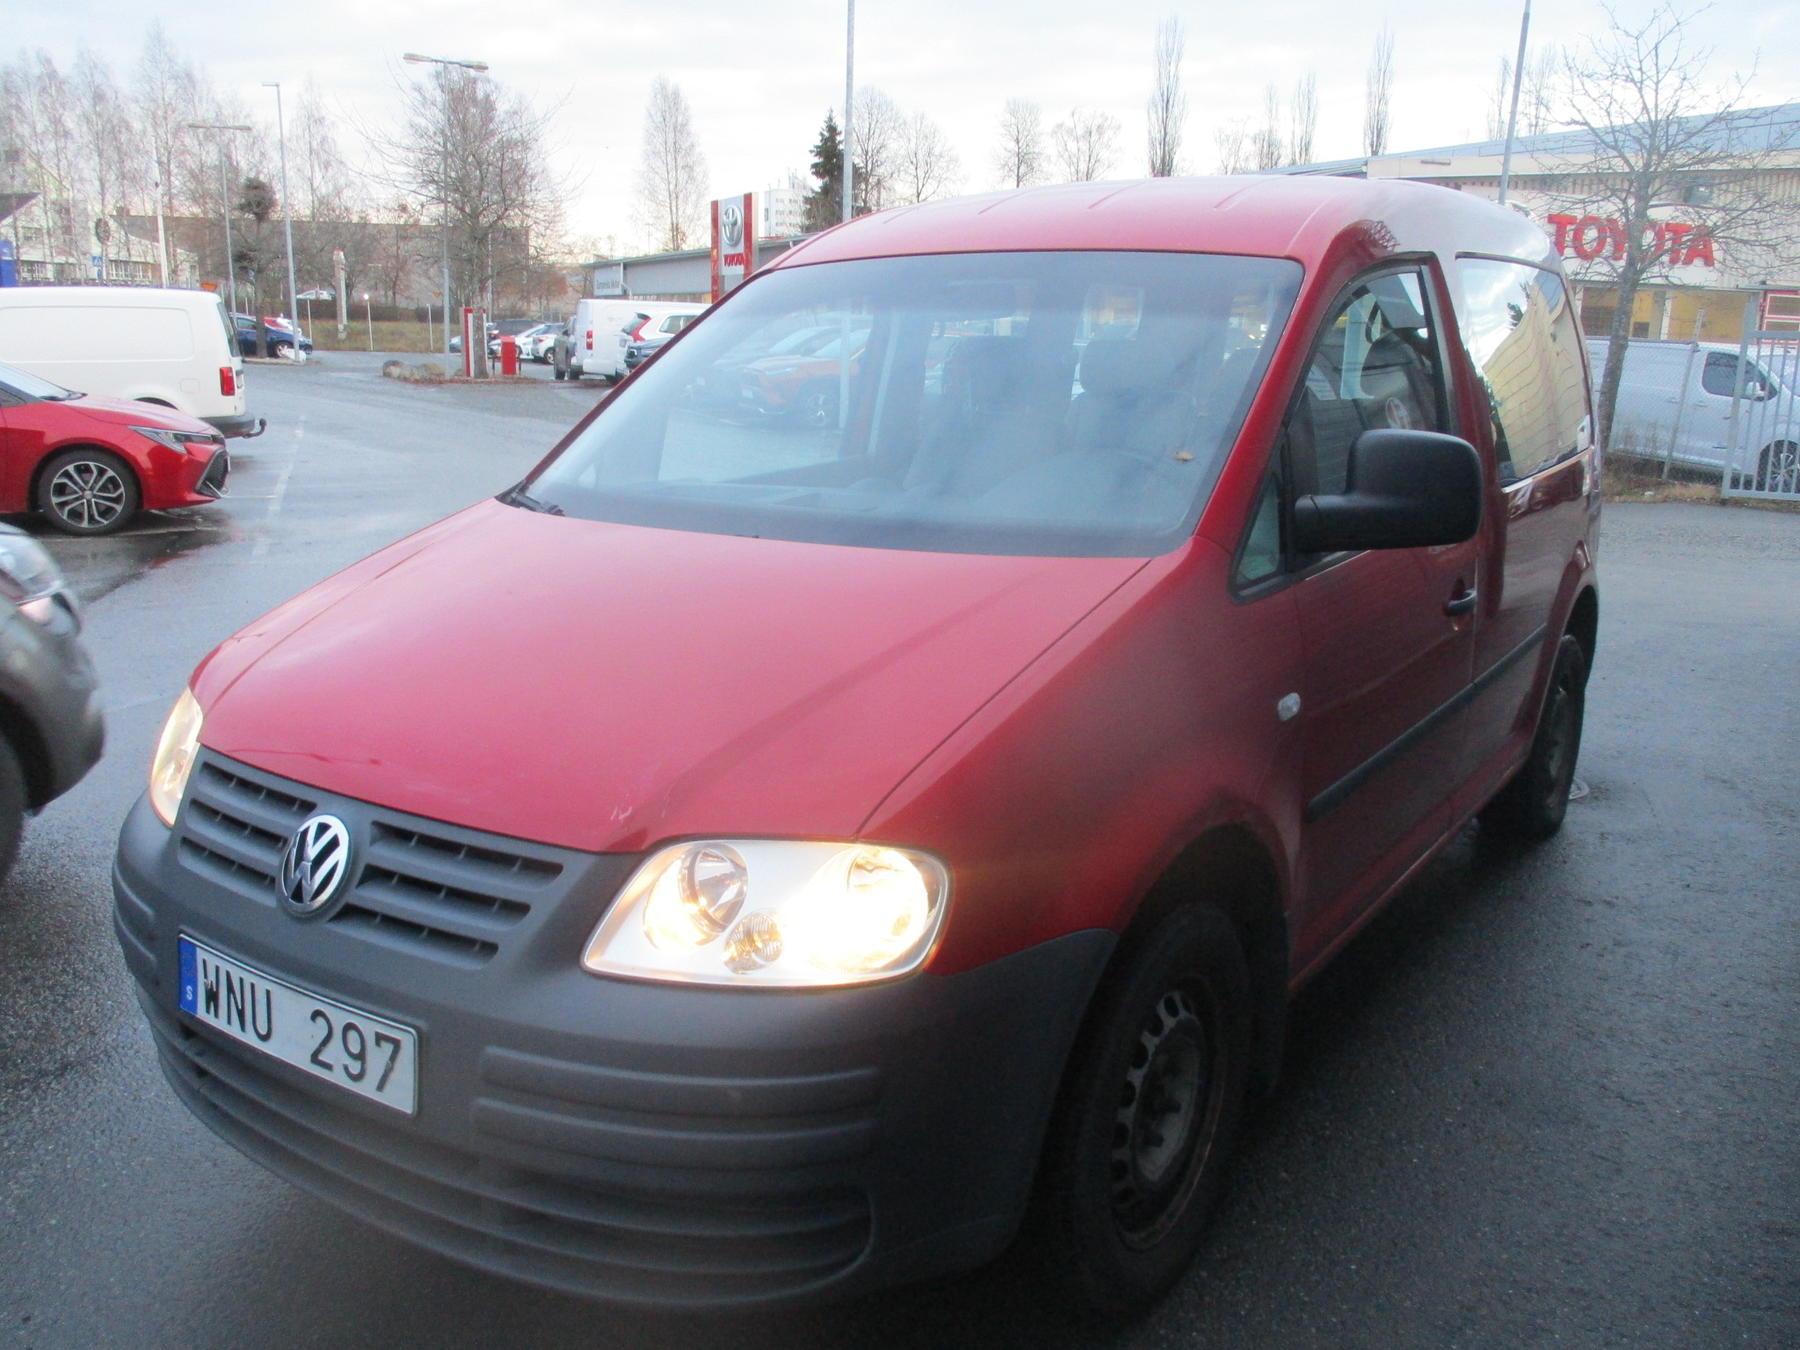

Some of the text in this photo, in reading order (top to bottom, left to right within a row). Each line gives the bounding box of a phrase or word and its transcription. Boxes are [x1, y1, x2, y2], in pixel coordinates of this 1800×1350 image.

[1547, 213, 1715, 267] TOYOTA
[202, 957, 402, 1093] WNU 297
